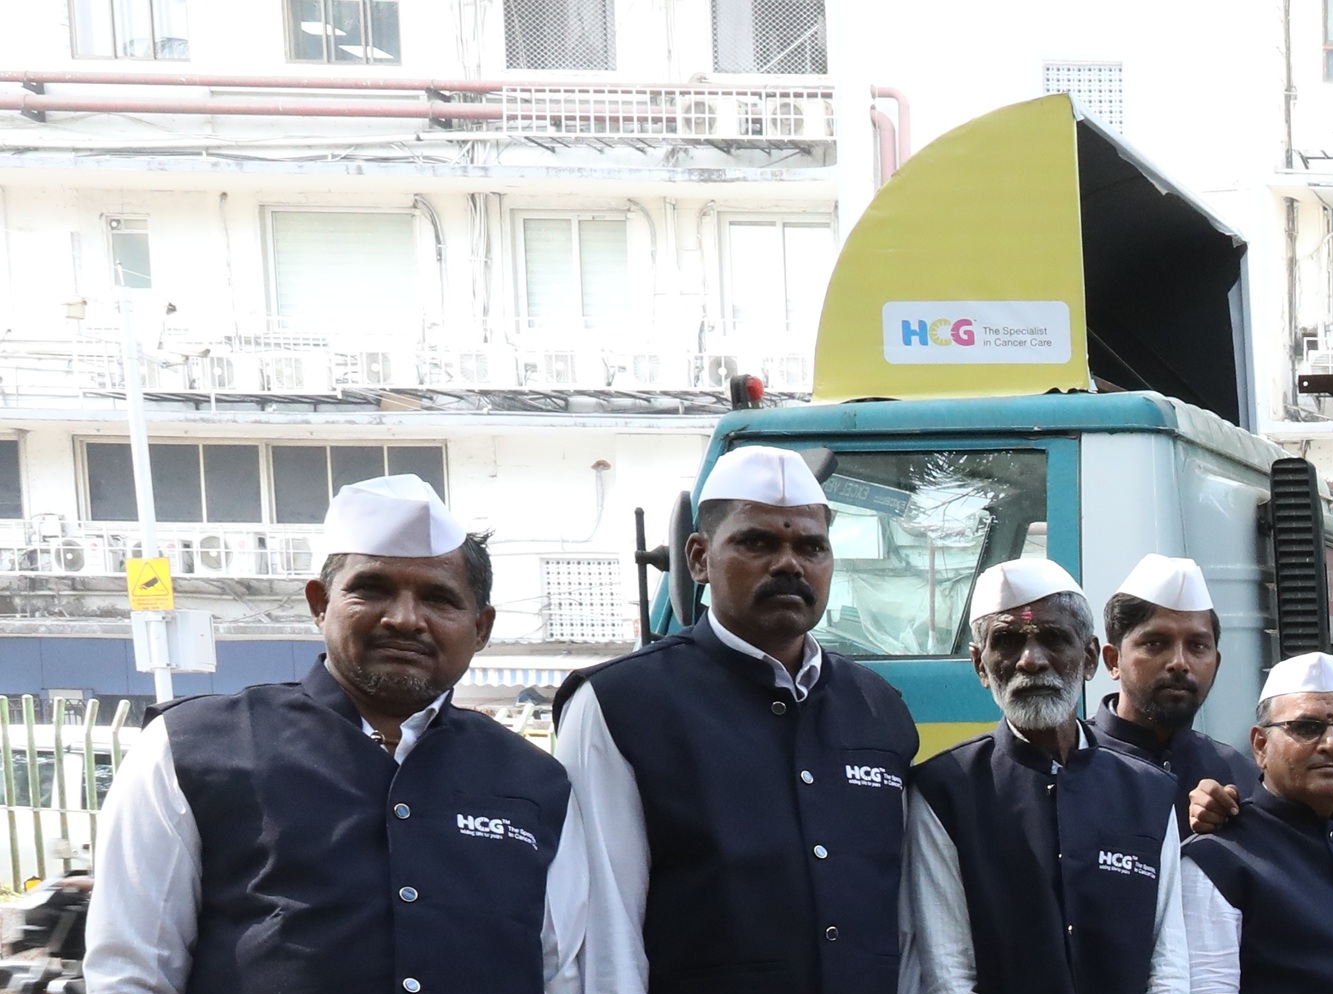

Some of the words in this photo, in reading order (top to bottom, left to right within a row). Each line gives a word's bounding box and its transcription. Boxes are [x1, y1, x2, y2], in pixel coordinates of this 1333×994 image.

[901, 318, 975, 347] HCG
[983, 326, 1000, 336] The
[1002, 326, 1047, 336] Specialist
[983, 338, 991, 347] in
[994, 338, 1027, 347] Cancer
[1029, 338, 1052, 347] Care
[845, 765, 881, 782] HCG
[456, 813, 504, 834] HCG
[1098, 850, 1132, 870] HCG
